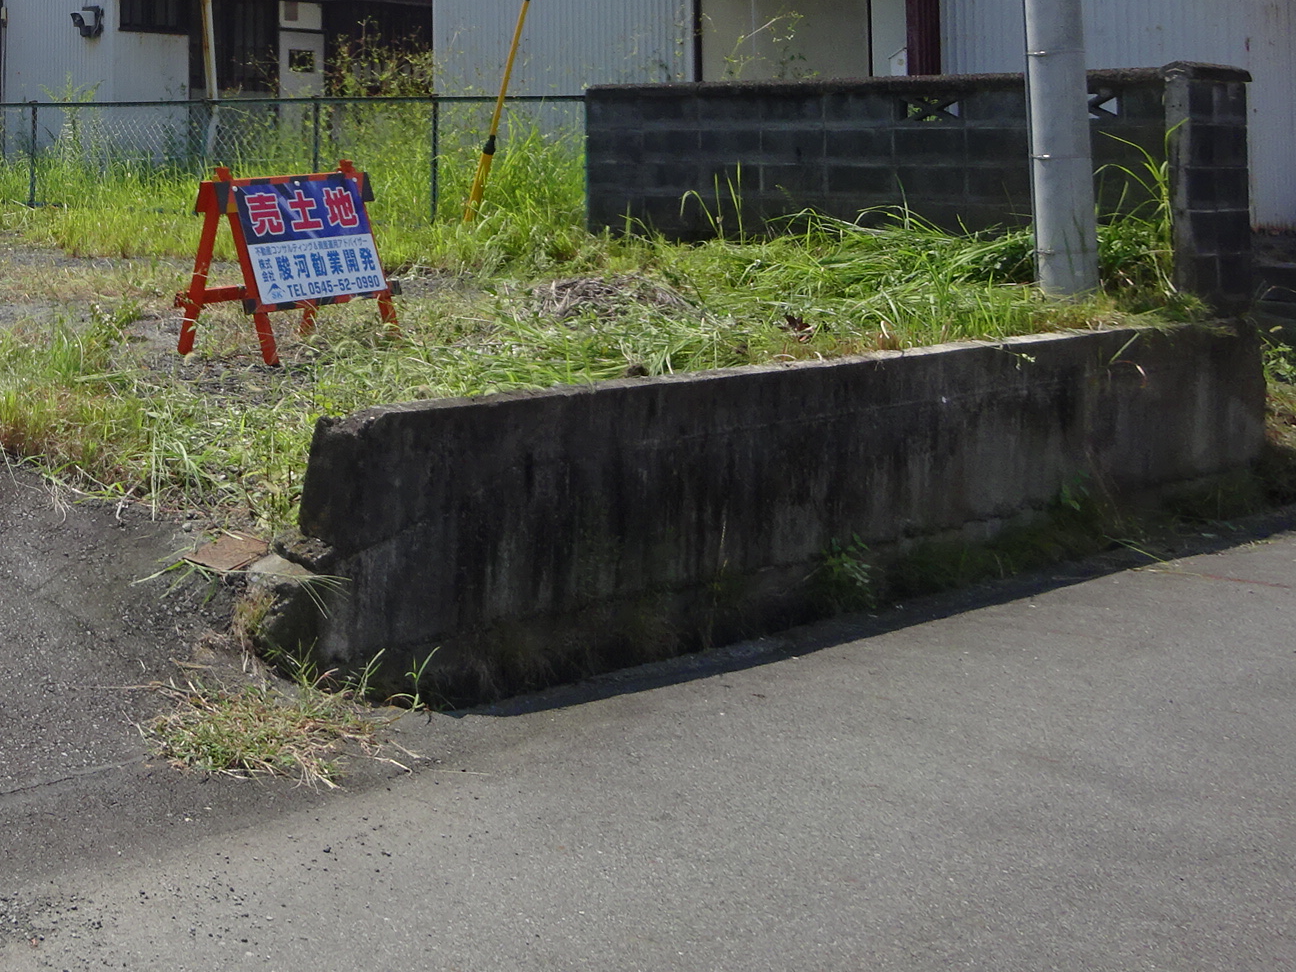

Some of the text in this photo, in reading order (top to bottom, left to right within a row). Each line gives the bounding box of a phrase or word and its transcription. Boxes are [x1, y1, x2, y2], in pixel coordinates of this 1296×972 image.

[245, 186, 359, 237] 売土地
[275, 247, 376, 281] 駿河勧業開発
[271, 292, 283, 300] SK
[287, 274, 381, 298] TEL 0545-52-0990
